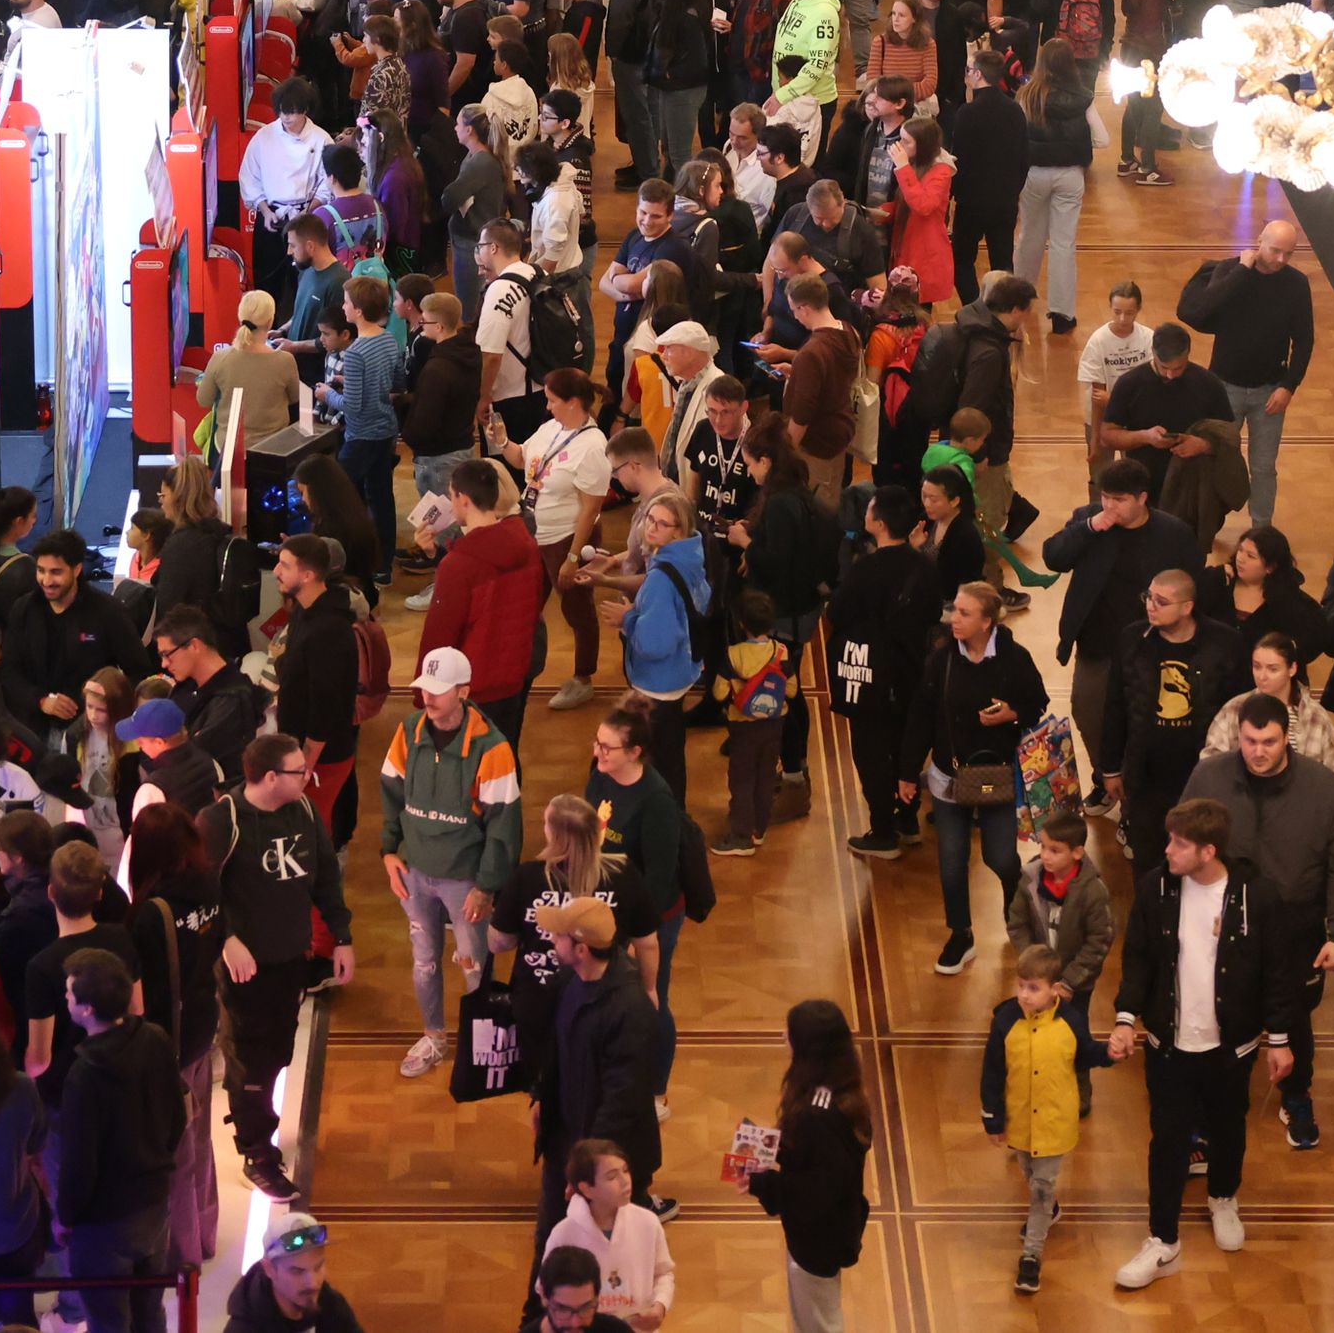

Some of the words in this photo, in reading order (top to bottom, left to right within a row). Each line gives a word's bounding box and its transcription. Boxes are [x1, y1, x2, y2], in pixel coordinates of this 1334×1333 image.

[816, 26, 835, 39] 63
[843, 640, 869, 667] I'M
[837, 661, 873, 683] WORTH
[845, 680, 862, 704] IT
[486, 1066, 509, 1089] IT
